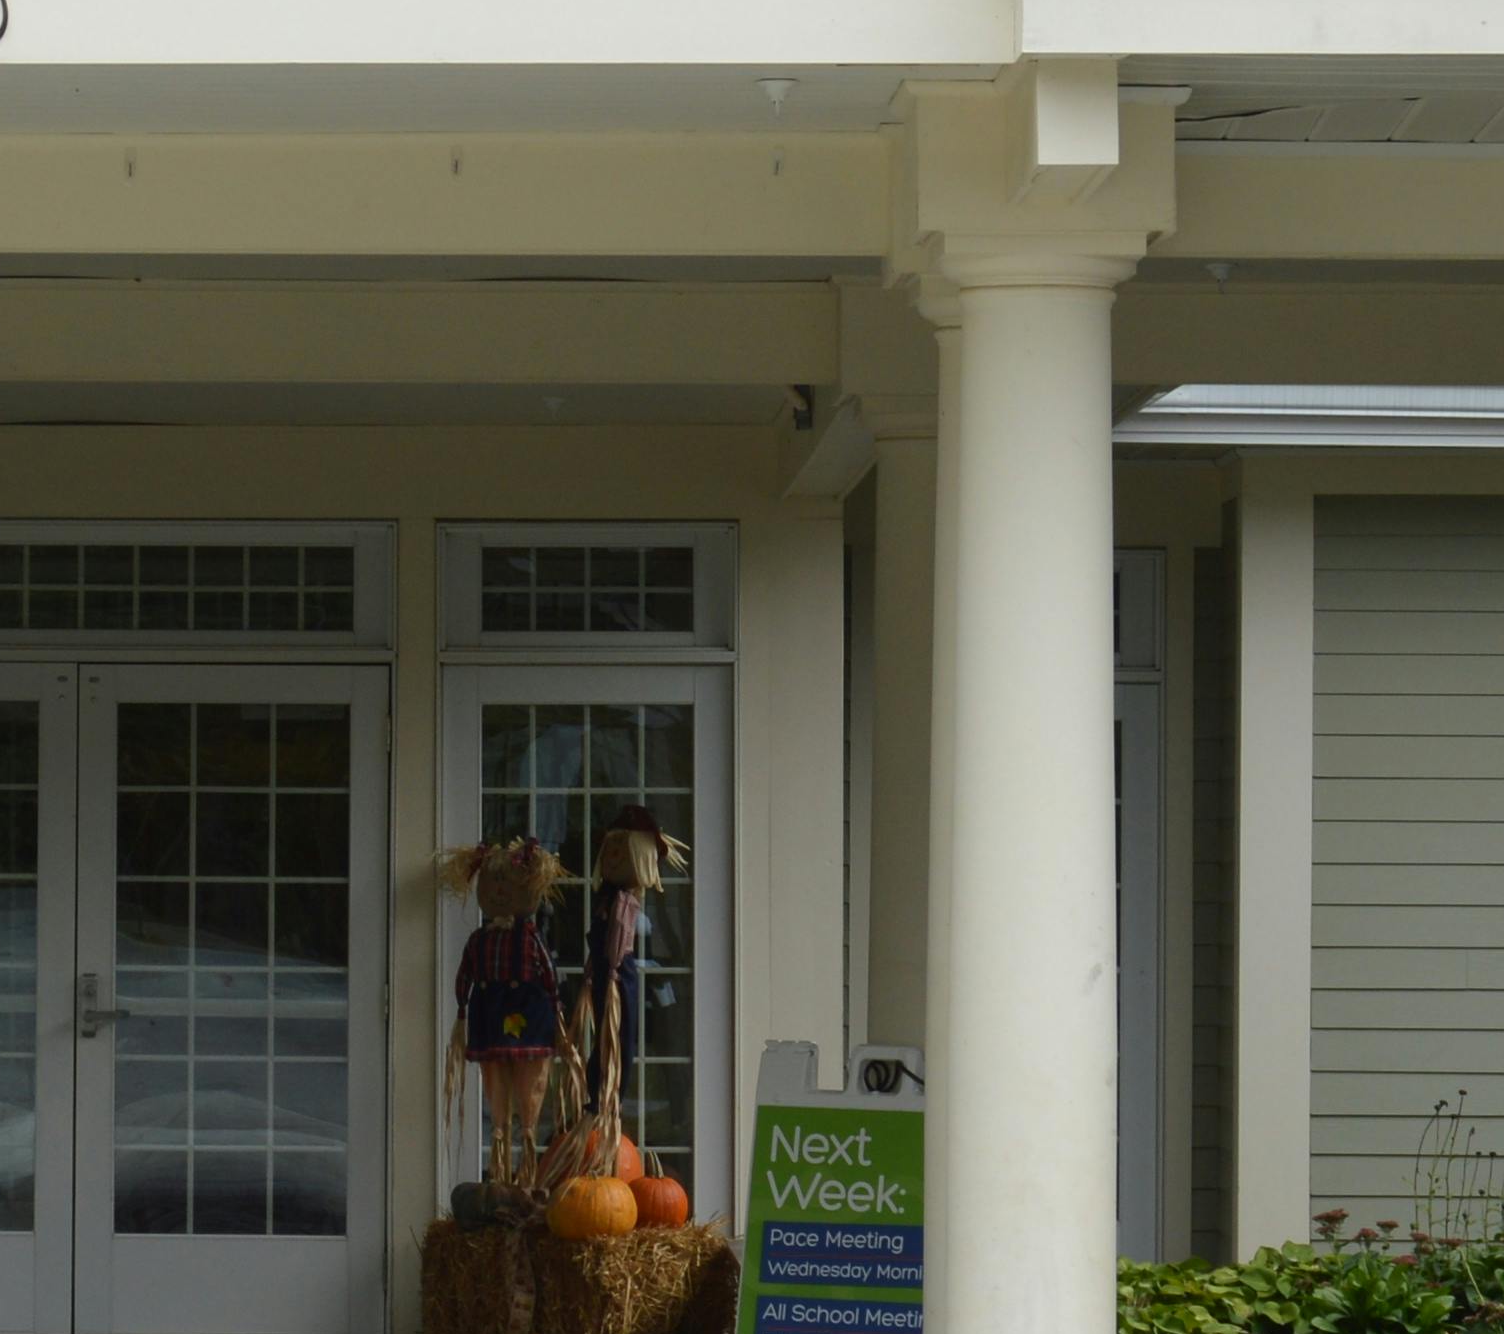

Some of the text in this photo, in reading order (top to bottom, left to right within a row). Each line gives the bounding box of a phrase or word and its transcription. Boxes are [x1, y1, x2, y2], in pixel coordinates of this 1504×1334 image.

[769, 1124, 872, 1167] Next
[766, 1170, 907, 1214] Week:
[770, 1228, 904, 1255] Pace Meeting
[767, 1260, 923, 1282] Wednesday Morni
[762, 1302, 923, 1329] All School Meeti
